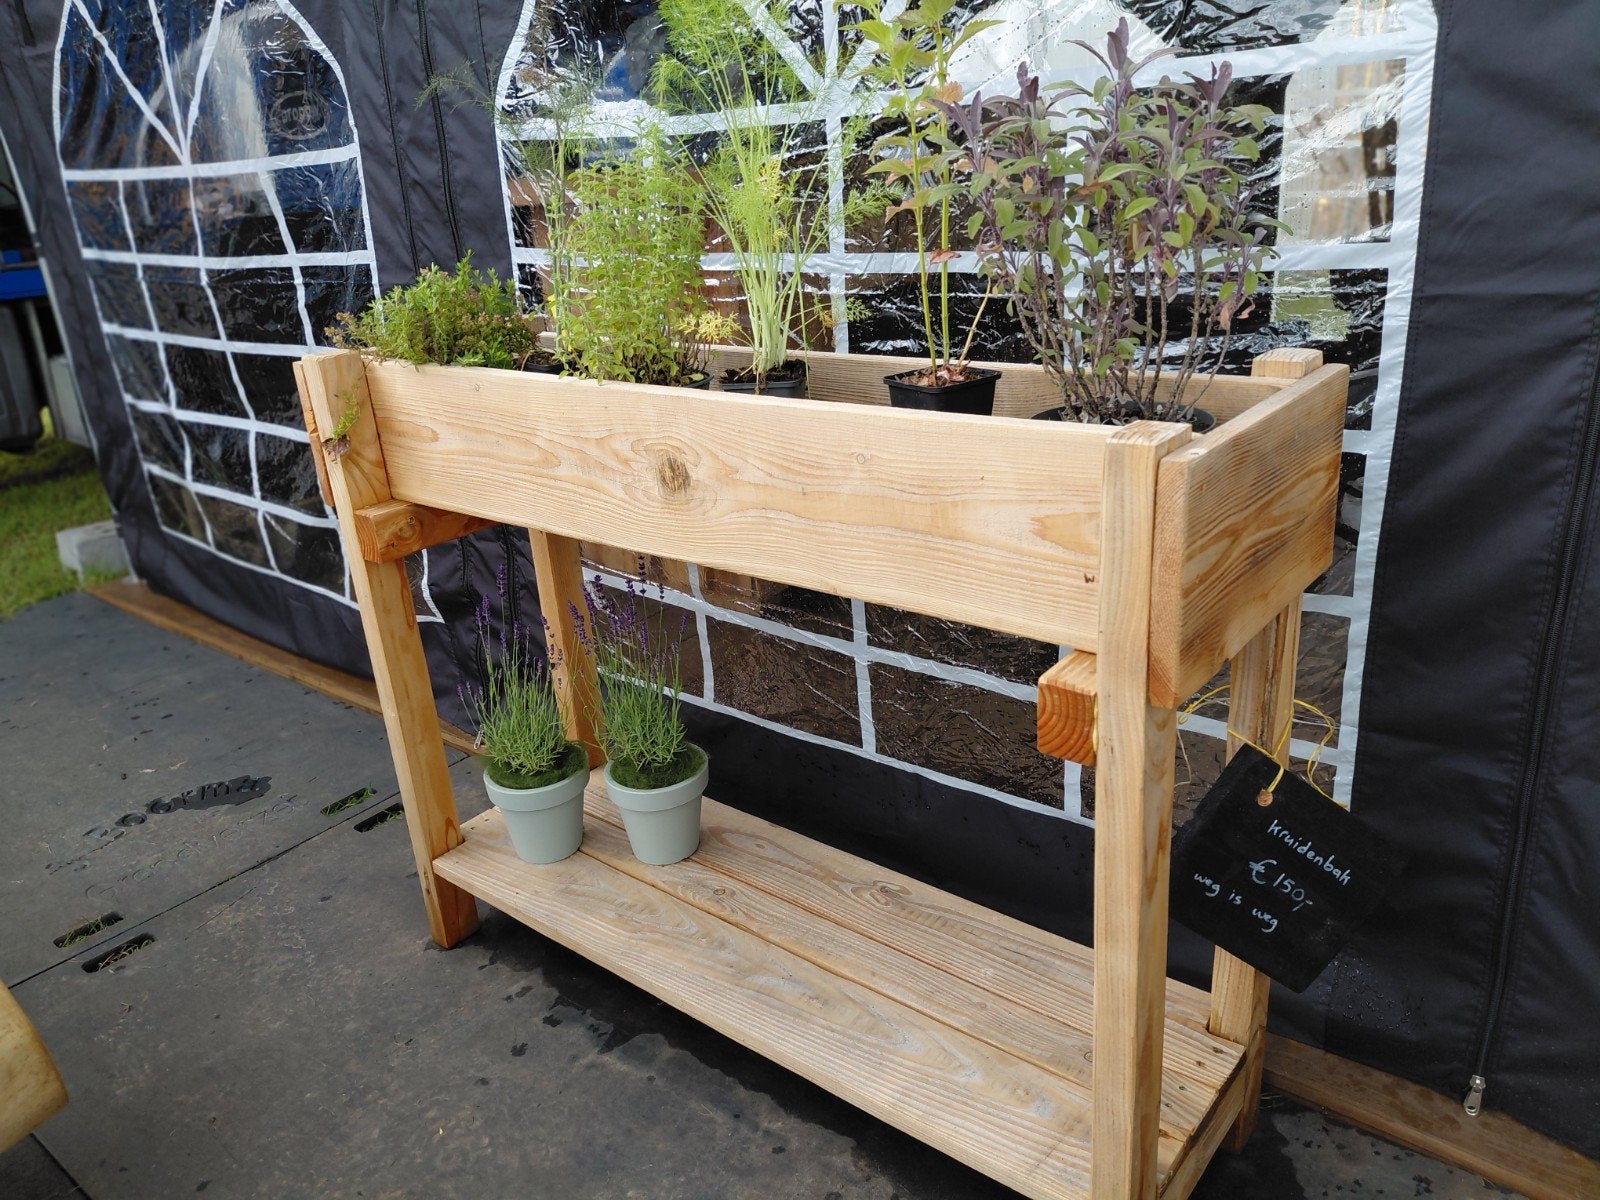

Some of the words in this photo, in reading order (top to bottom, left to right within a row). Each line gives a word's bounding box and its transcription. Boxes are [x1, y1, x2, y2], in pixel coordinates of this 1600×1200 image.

[1267, 819, 1351, 886] kruidenbak
[1194, 872, 1220, 897] weg
[1228, 889, 1242, 905] is
[1251, 907, 1279, 933] weg
